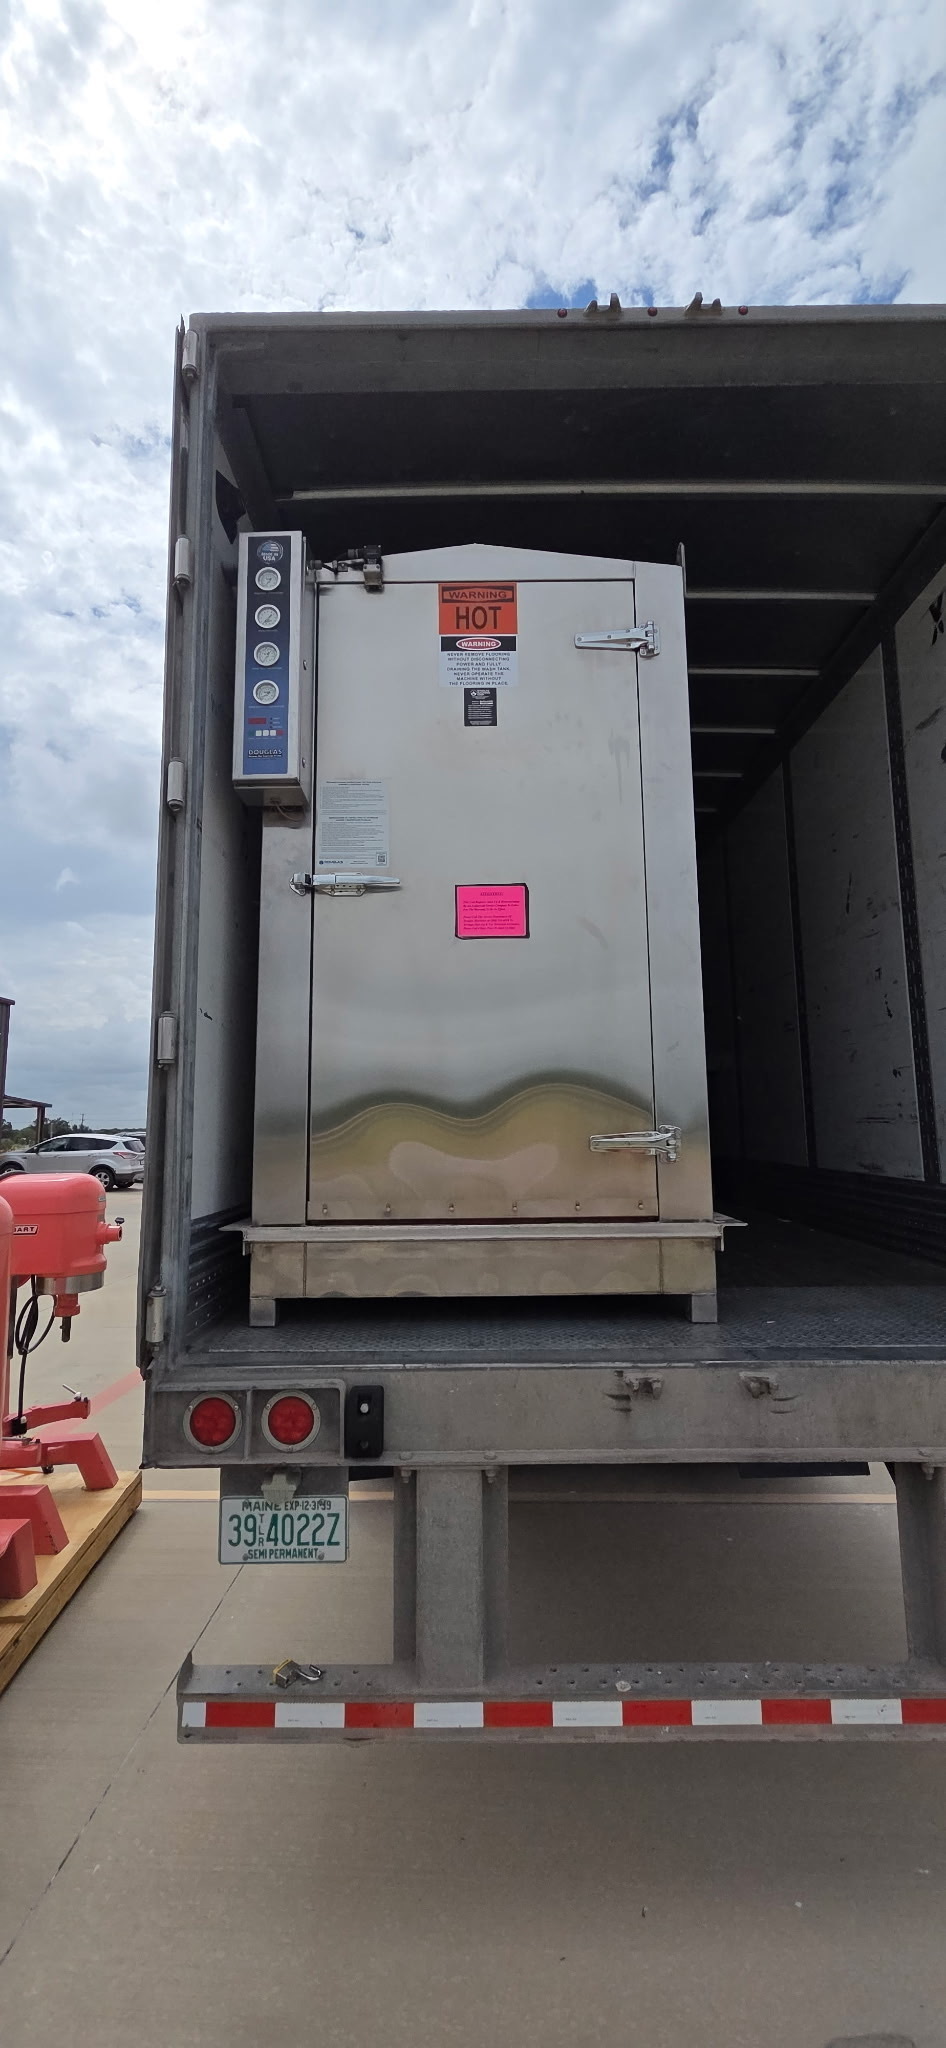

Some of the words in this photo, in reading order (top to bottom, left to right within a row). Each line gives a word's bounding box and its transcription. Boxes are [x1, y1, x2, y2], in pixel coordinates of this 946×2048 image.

[449, 591, 507, 599] WARNING
[456, 606, 502, 630] HOT
[242, 1500, 281, 1511] MAINE
[228, 1514, 257, 1547] 39
[266, 1513, 340, 1547] 4022Z
[248, 1549, 268, 1560] SEMI
[269, 1548, 319, 1559] PERMANENT
